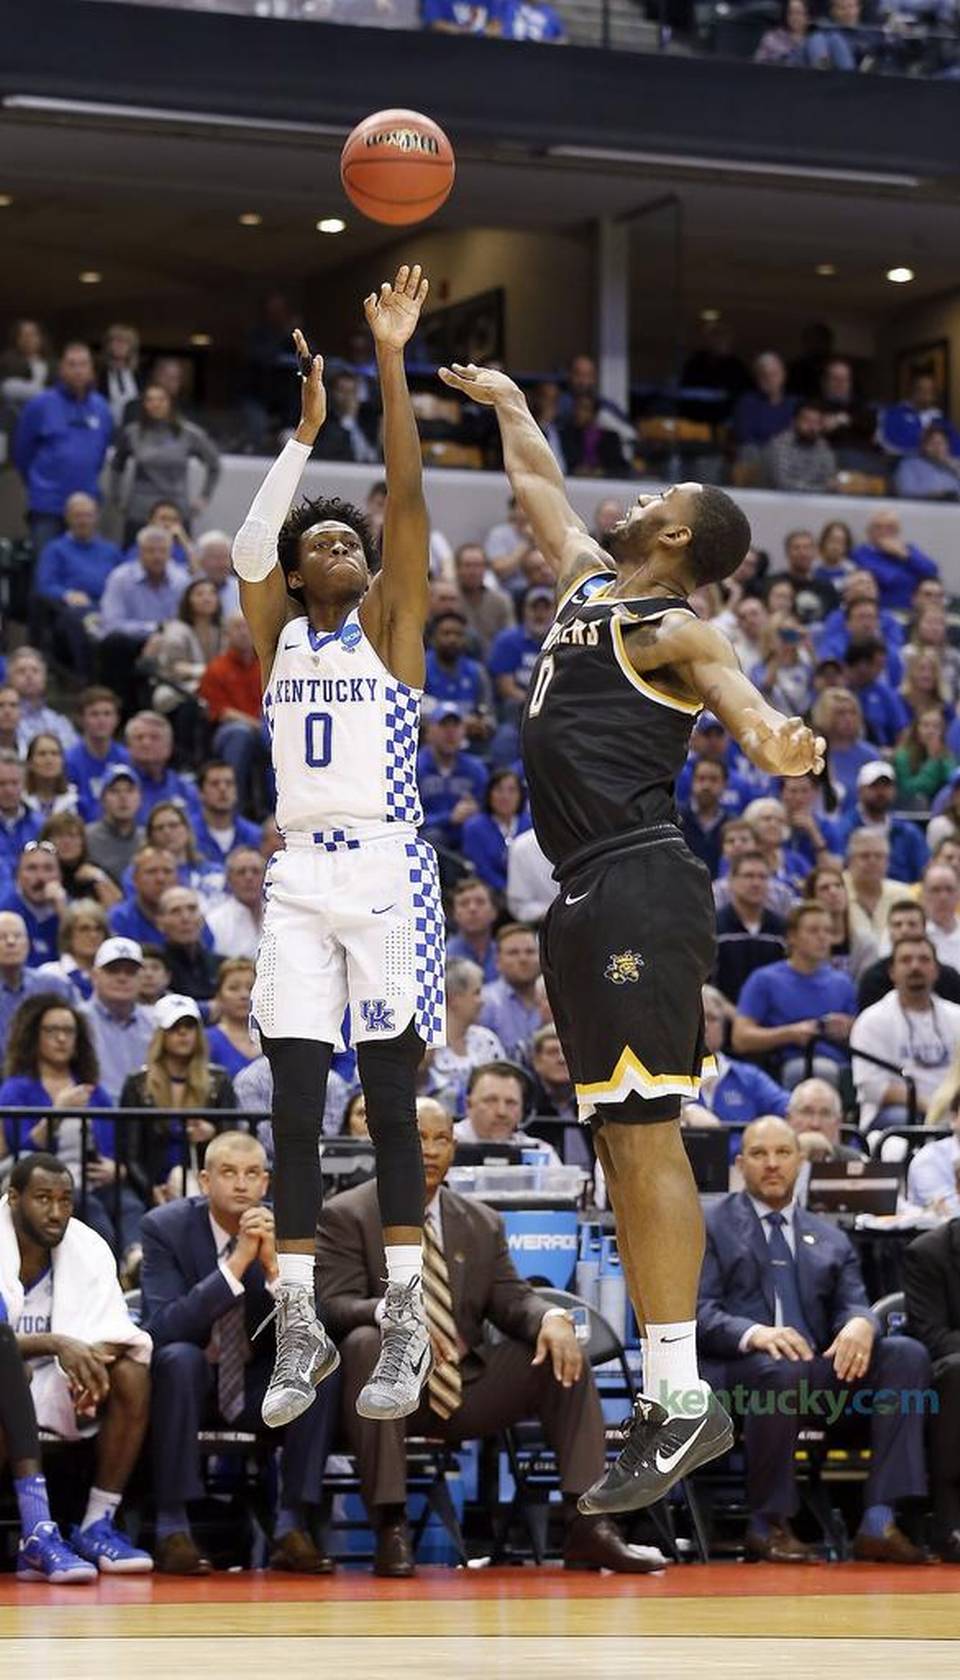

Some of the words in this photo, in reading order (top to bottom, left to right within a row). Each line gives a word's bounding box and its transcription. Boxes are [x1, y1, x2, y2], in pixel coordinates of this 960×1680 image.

[275, 678, 377, 703] KENTUCKY
[529, 654, 554, 719] 0
[305, 713, 332, 768] 0
[360, 999, 395, 1032] UK
